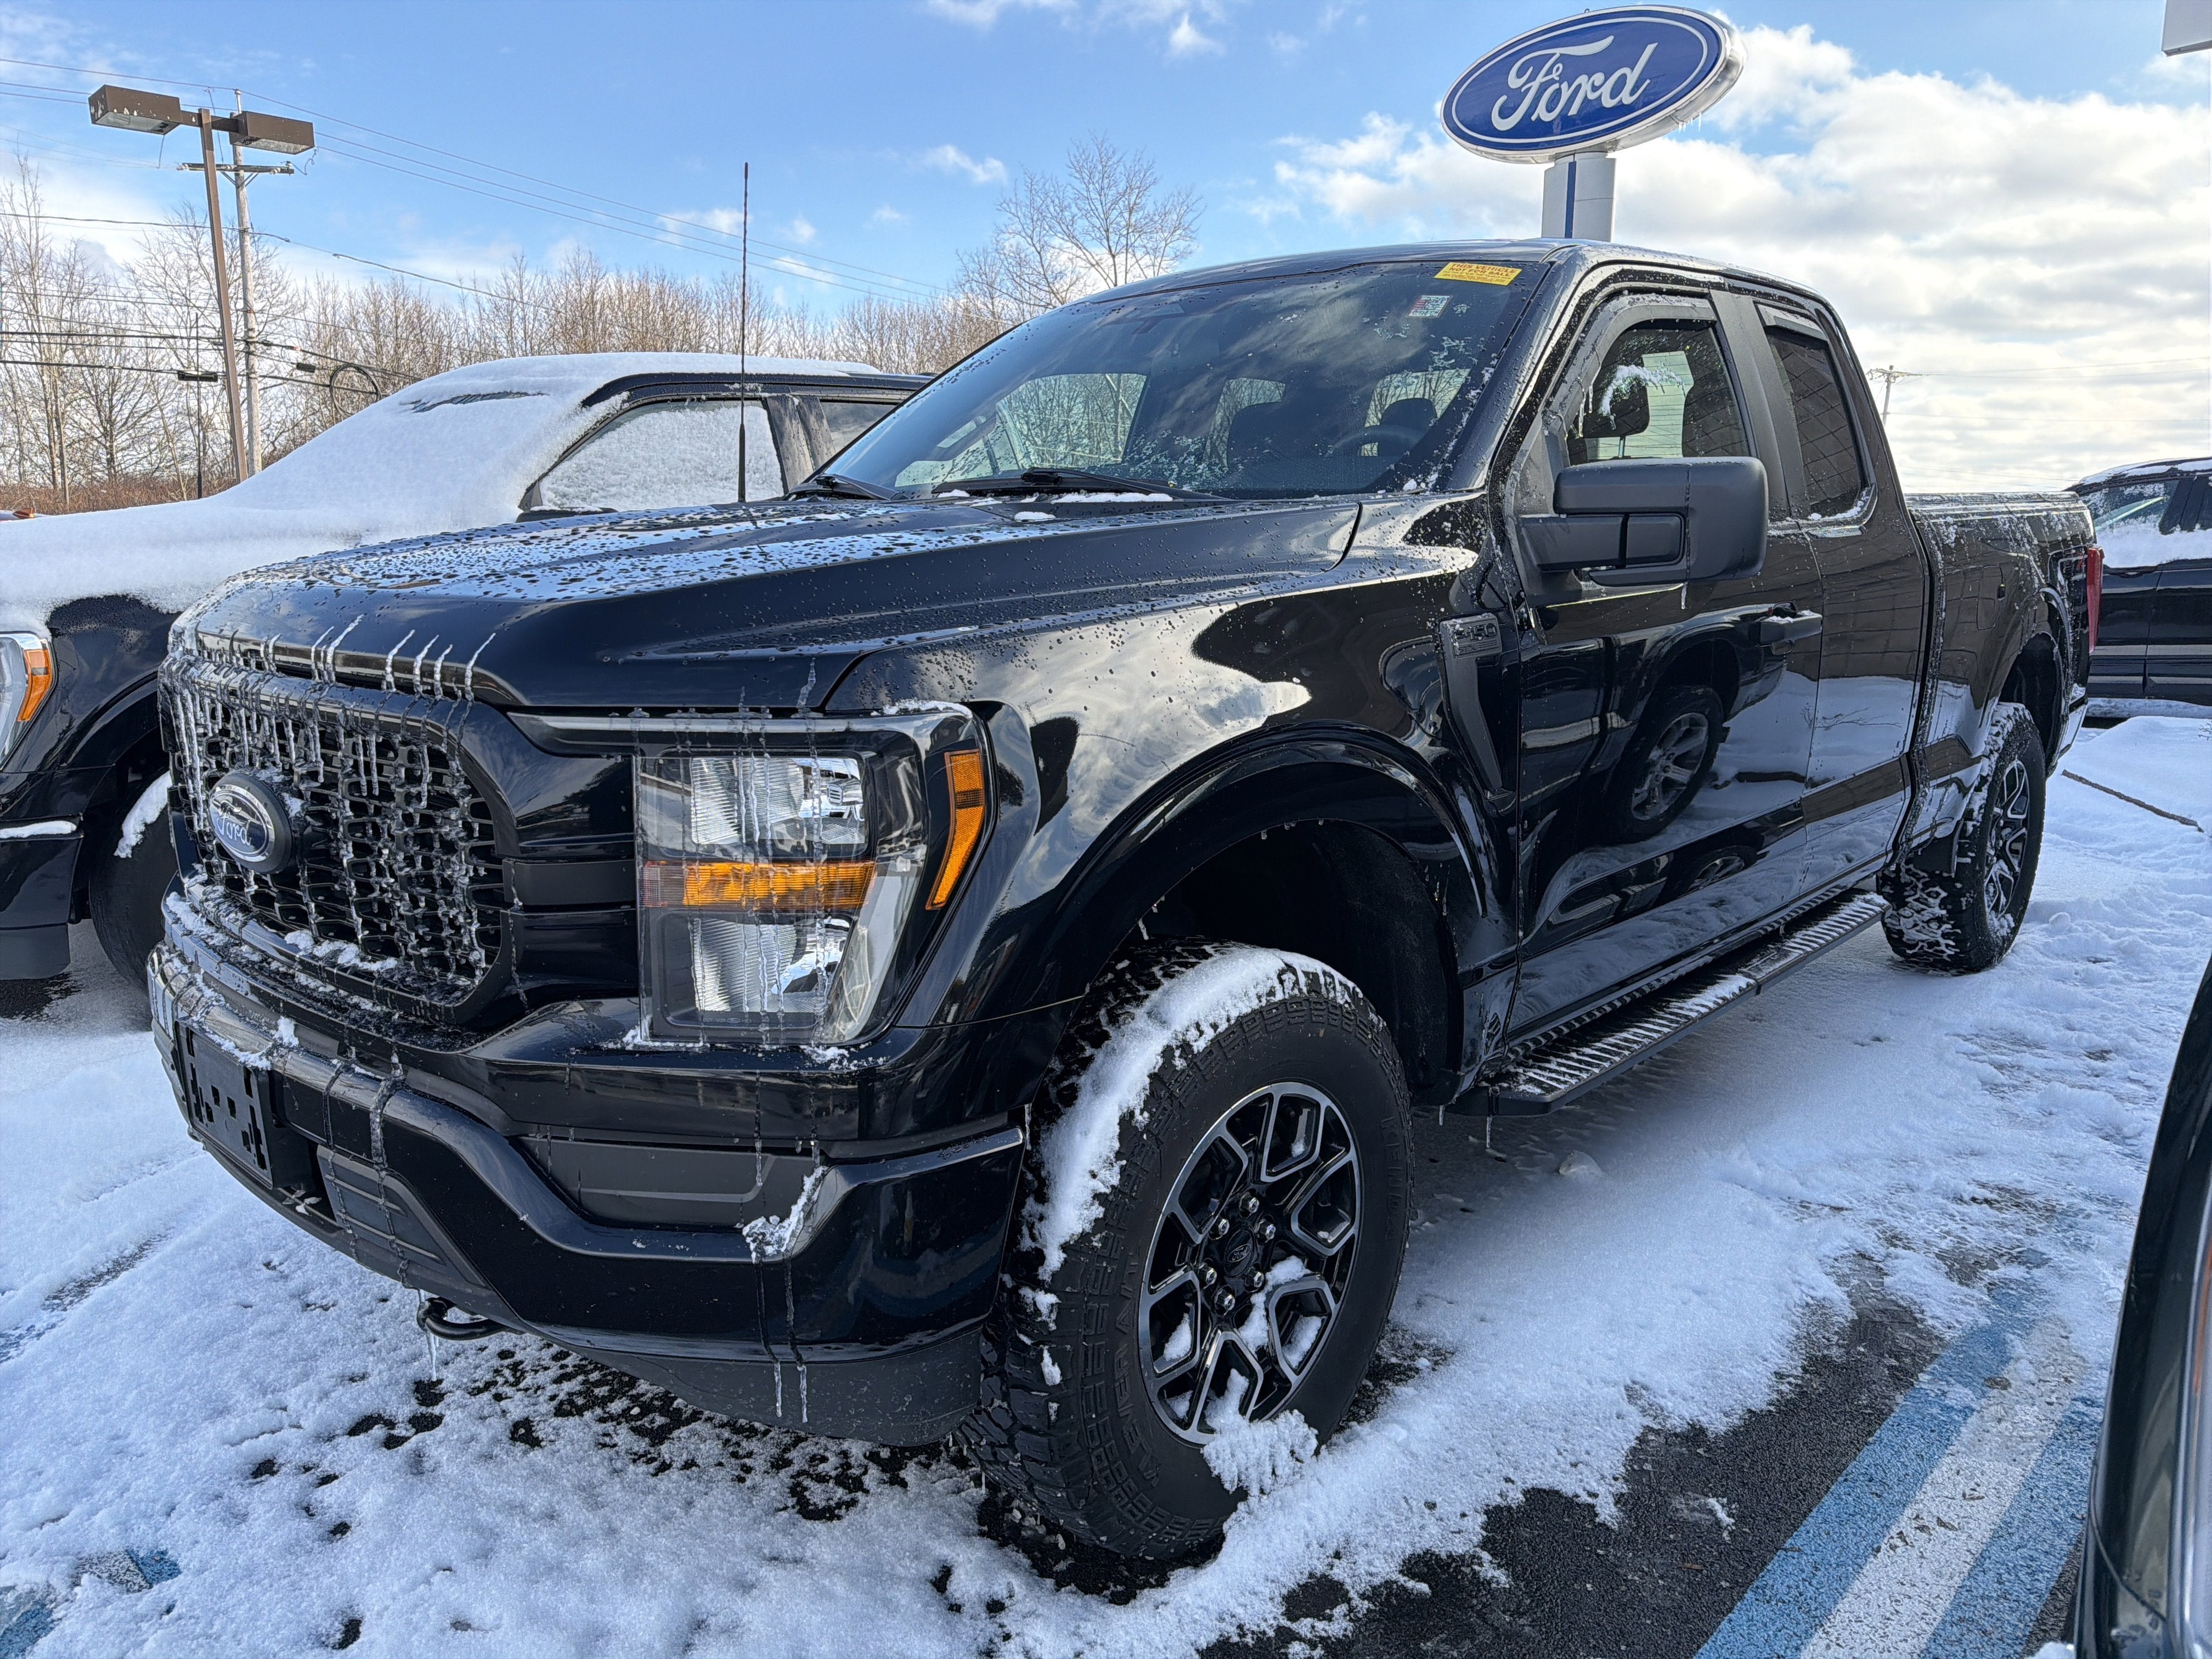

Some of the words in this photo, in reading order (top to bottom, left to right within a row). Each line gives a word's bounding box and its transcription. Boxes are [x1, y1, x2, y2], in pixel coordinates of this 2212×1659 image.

[1491, 35, 1658, 131] Ford
[1476, 265, 1517, 273] VEHICLE
[217, 799, 252, 846] Ford
